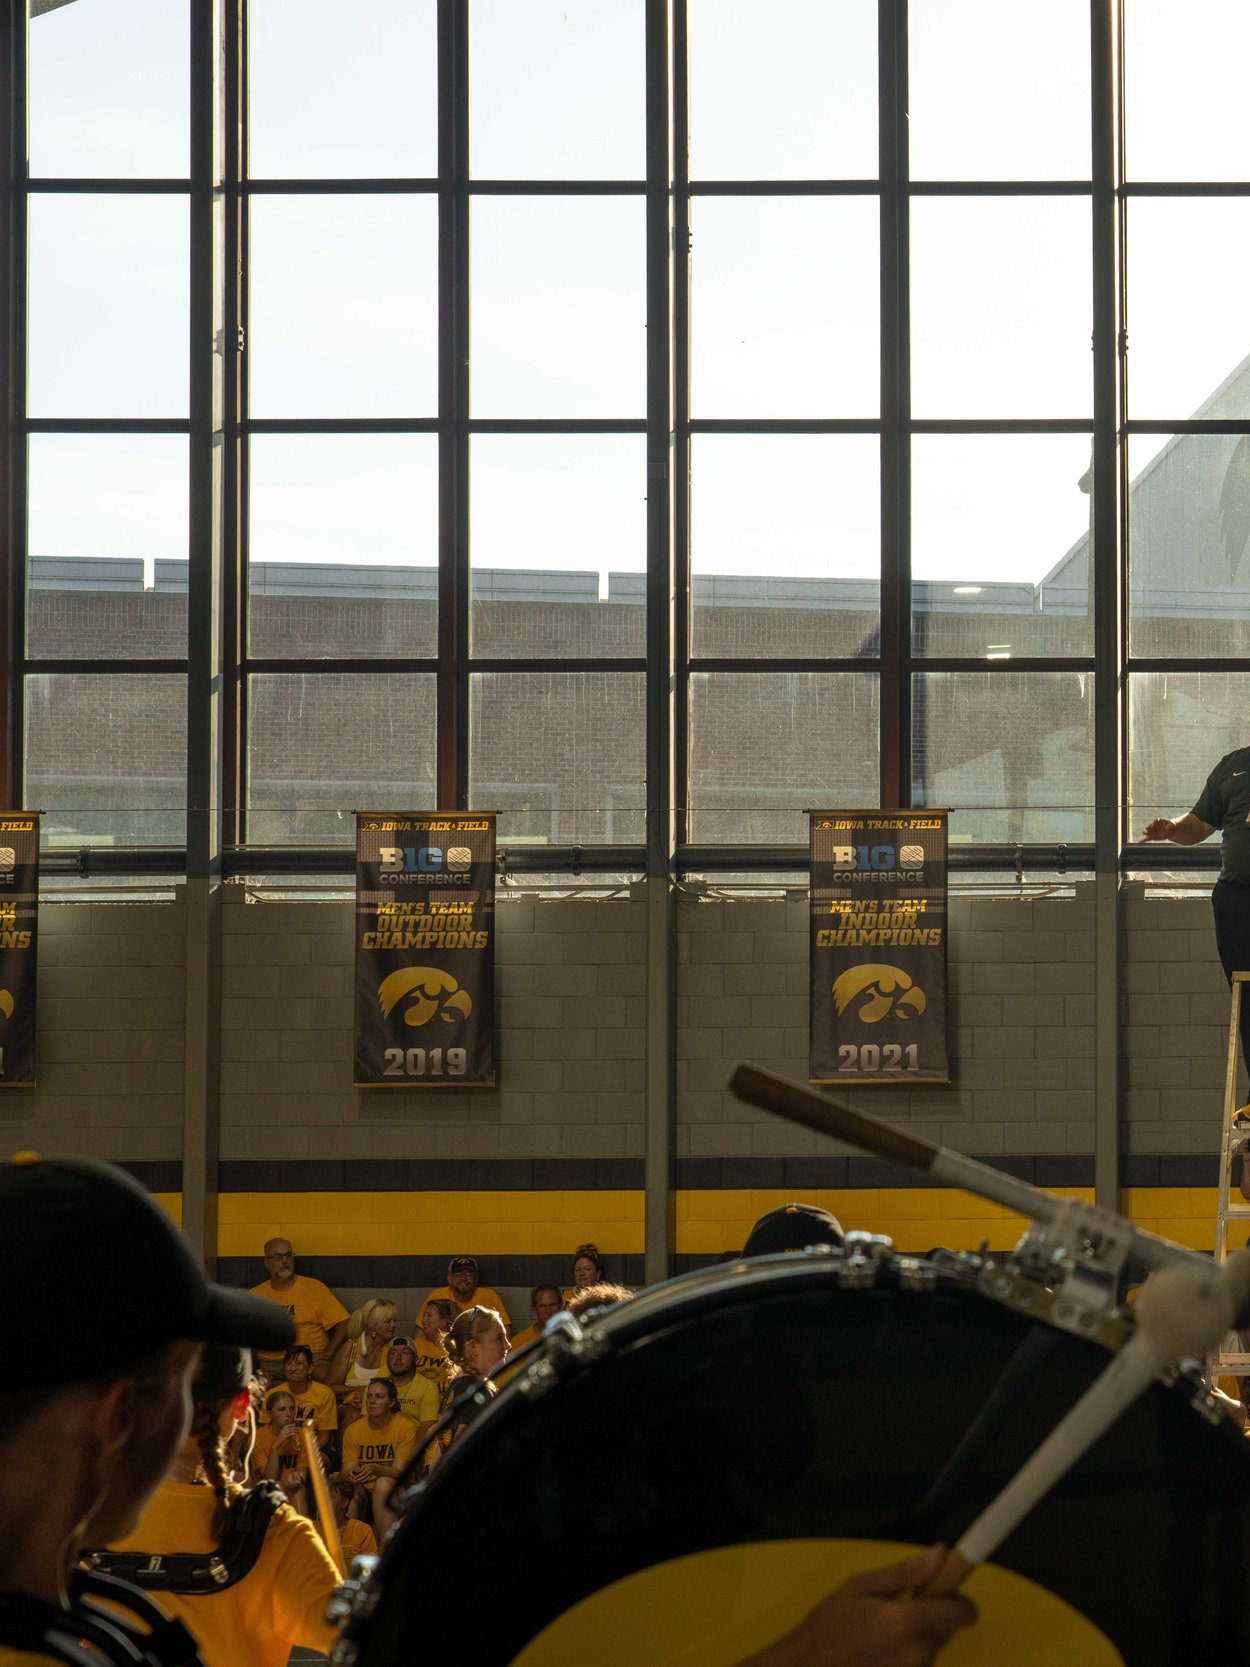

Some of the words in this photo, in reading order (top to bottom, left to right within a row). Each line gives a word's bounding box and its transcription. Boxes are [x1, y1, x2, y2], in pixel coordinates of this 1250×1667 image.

[1, 821, 33, 831] FIELD
[381, 822, 411, 831] IOWA
[414, 822, 451, 831] TRACK
[457, 821, 489, 831] FIELD
[834, 820, 864, 830] IOWA
[867, 820, 903, 830] TRACK
[909, 819, 942, 830] FIELD
[379, 873, 471, 885] CONFERENCE
[833, 872, 924, 883] CONFERENCE
[376, 902, 425, 915] MEN'S
[430, 901, 474, 914] TEAM
[830, 900, 879, 913] MEN'S
[883, 900, 927, 913] TEAM
[377, 914, 473, 932] OUTDOOR
[838, 912, 918, 929] INDOOR
[362, 931, 489, 949] CHAMPIONS
[816, 928, 942, 947] CHAMPIONS
[383, 1047, 467, 1076] 2019
[838, 1043, 919, 1072] 2021
[358, 1444, 396, 1460] IOWA
